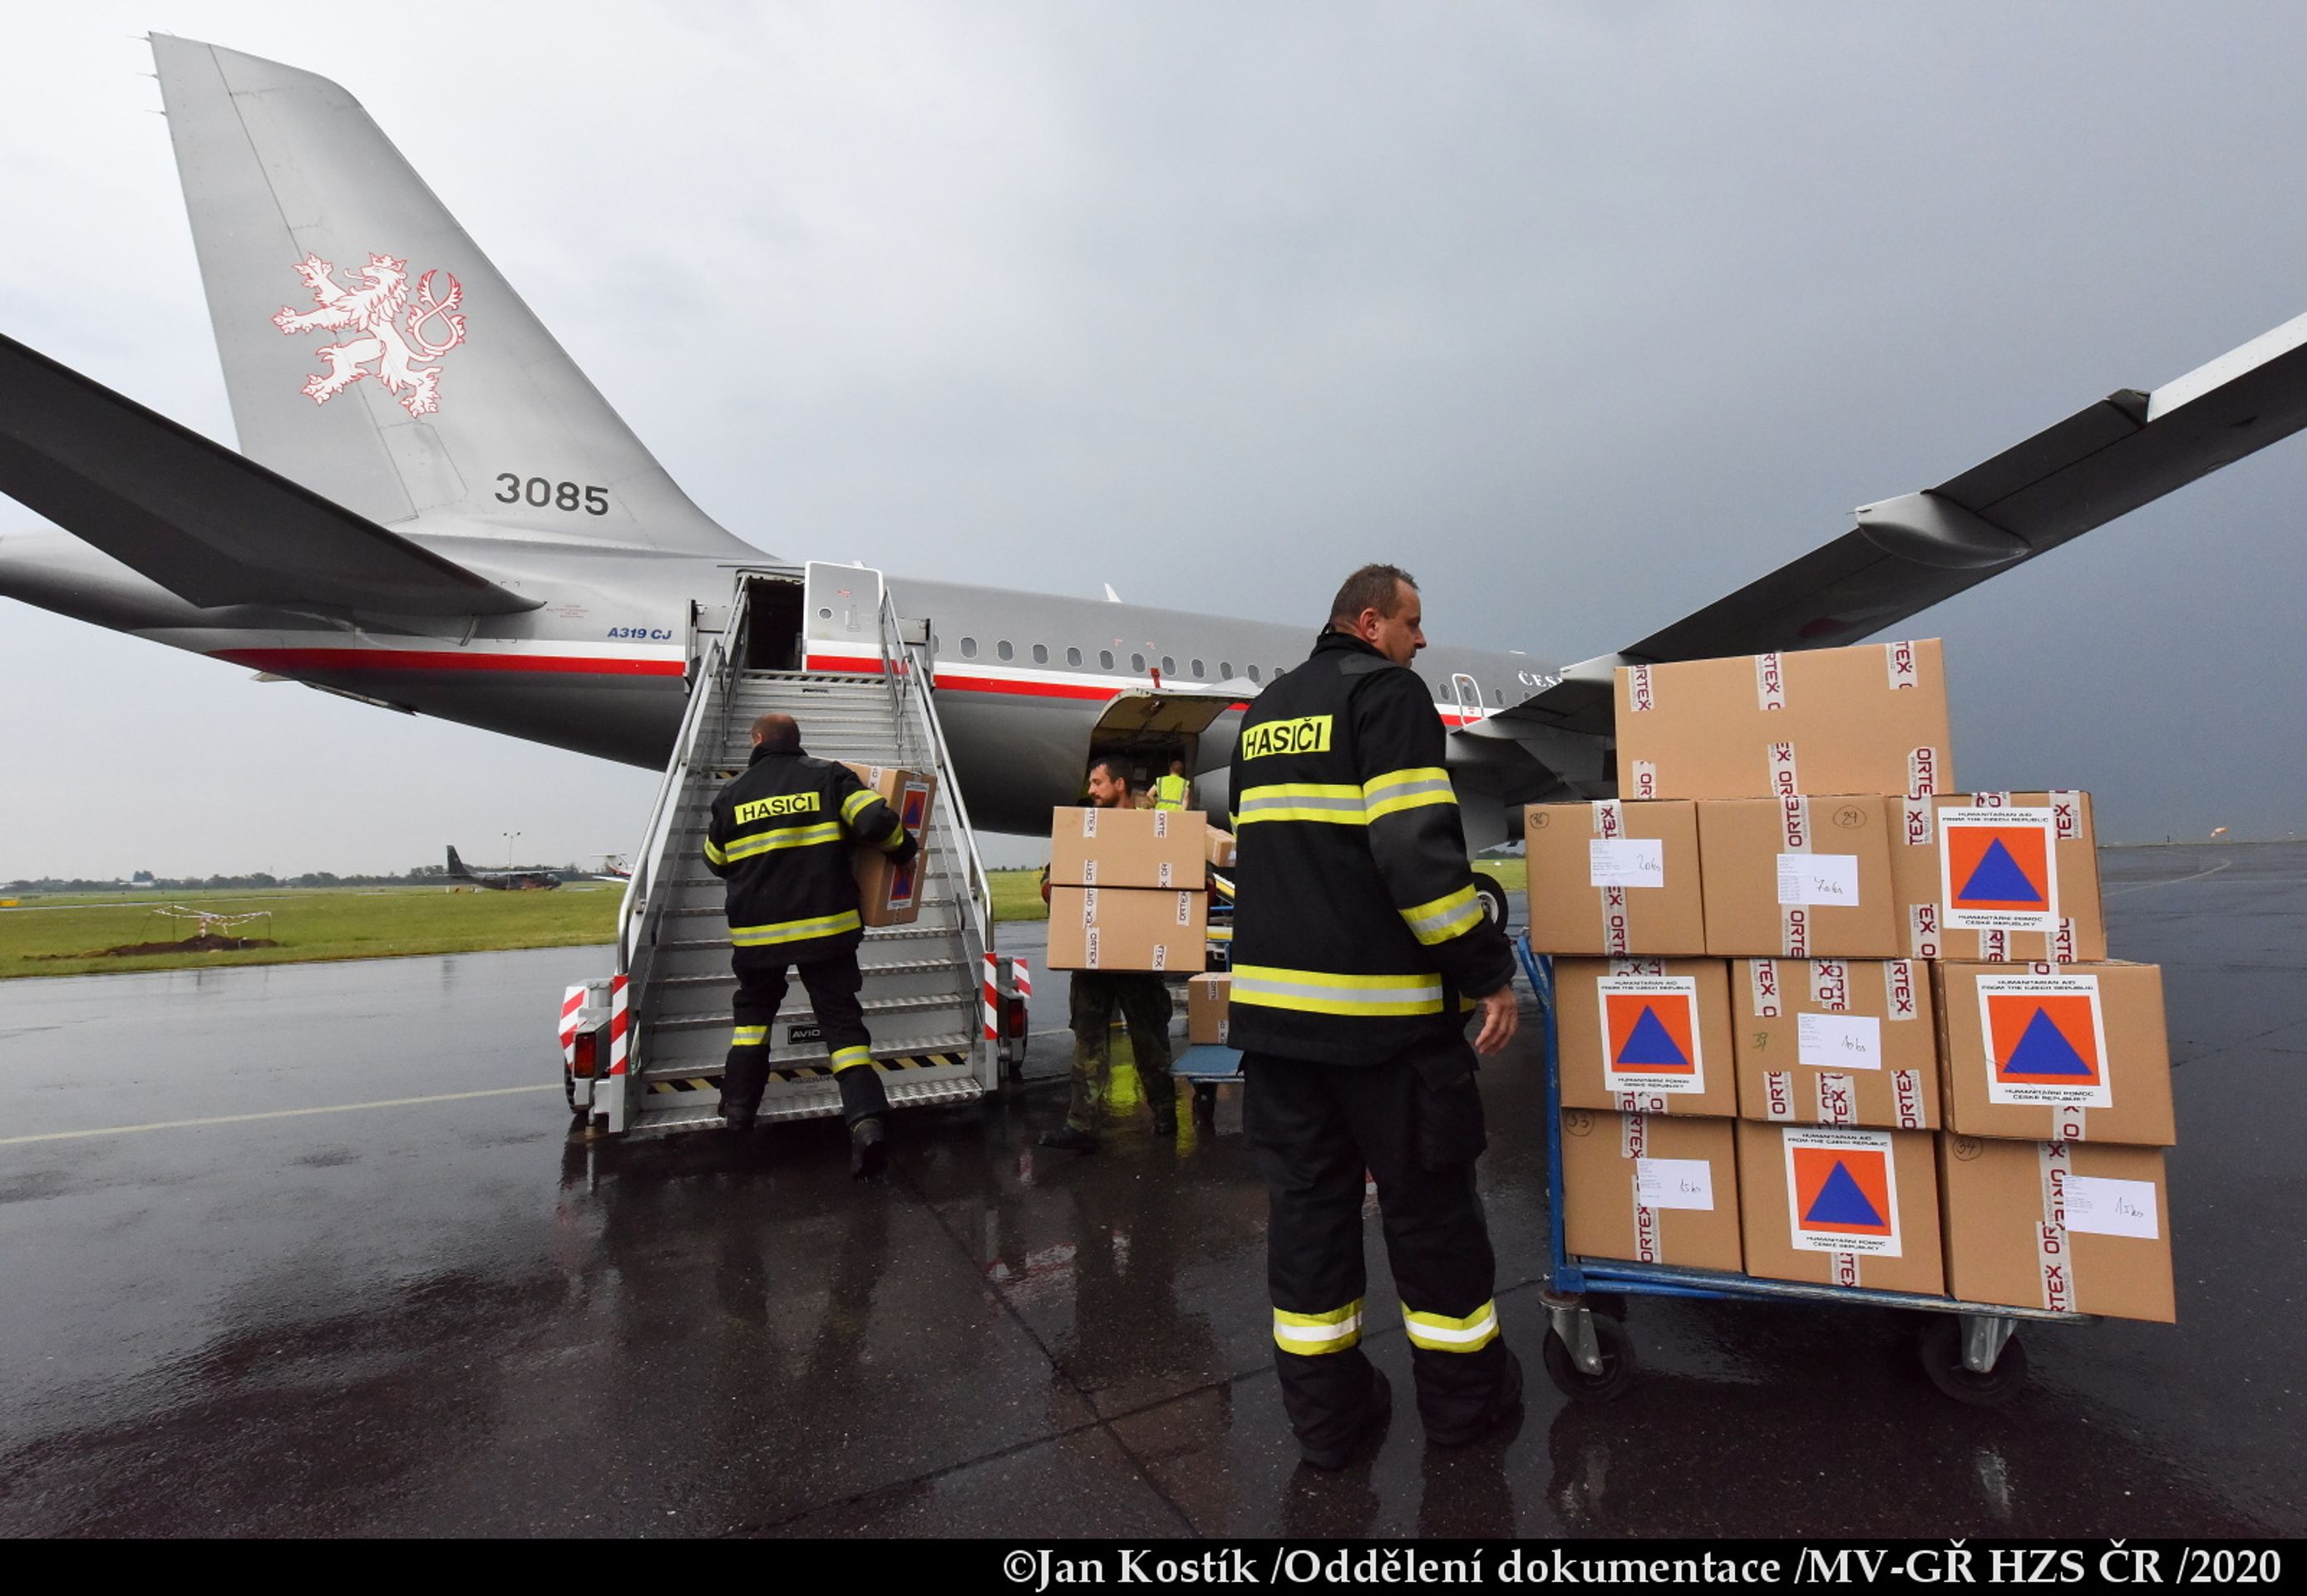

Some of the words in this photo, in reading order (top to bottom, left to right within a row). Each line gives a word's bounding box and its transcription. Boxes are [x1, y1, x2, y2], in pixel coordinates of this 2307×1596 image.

[494, 472, 609, 516] 3085
[607, 627, 648, 639] A319
[650, 628, 673, 640] CJ
[1245, 717, 1322, 758] HASIČI
[742, 793, 813, 821] HASIČI
[1919, 904, 1937, 933] EX
[792, 1029, 821, 1038] AVIO
[1840, 1253, 1856, 1287] TEX
